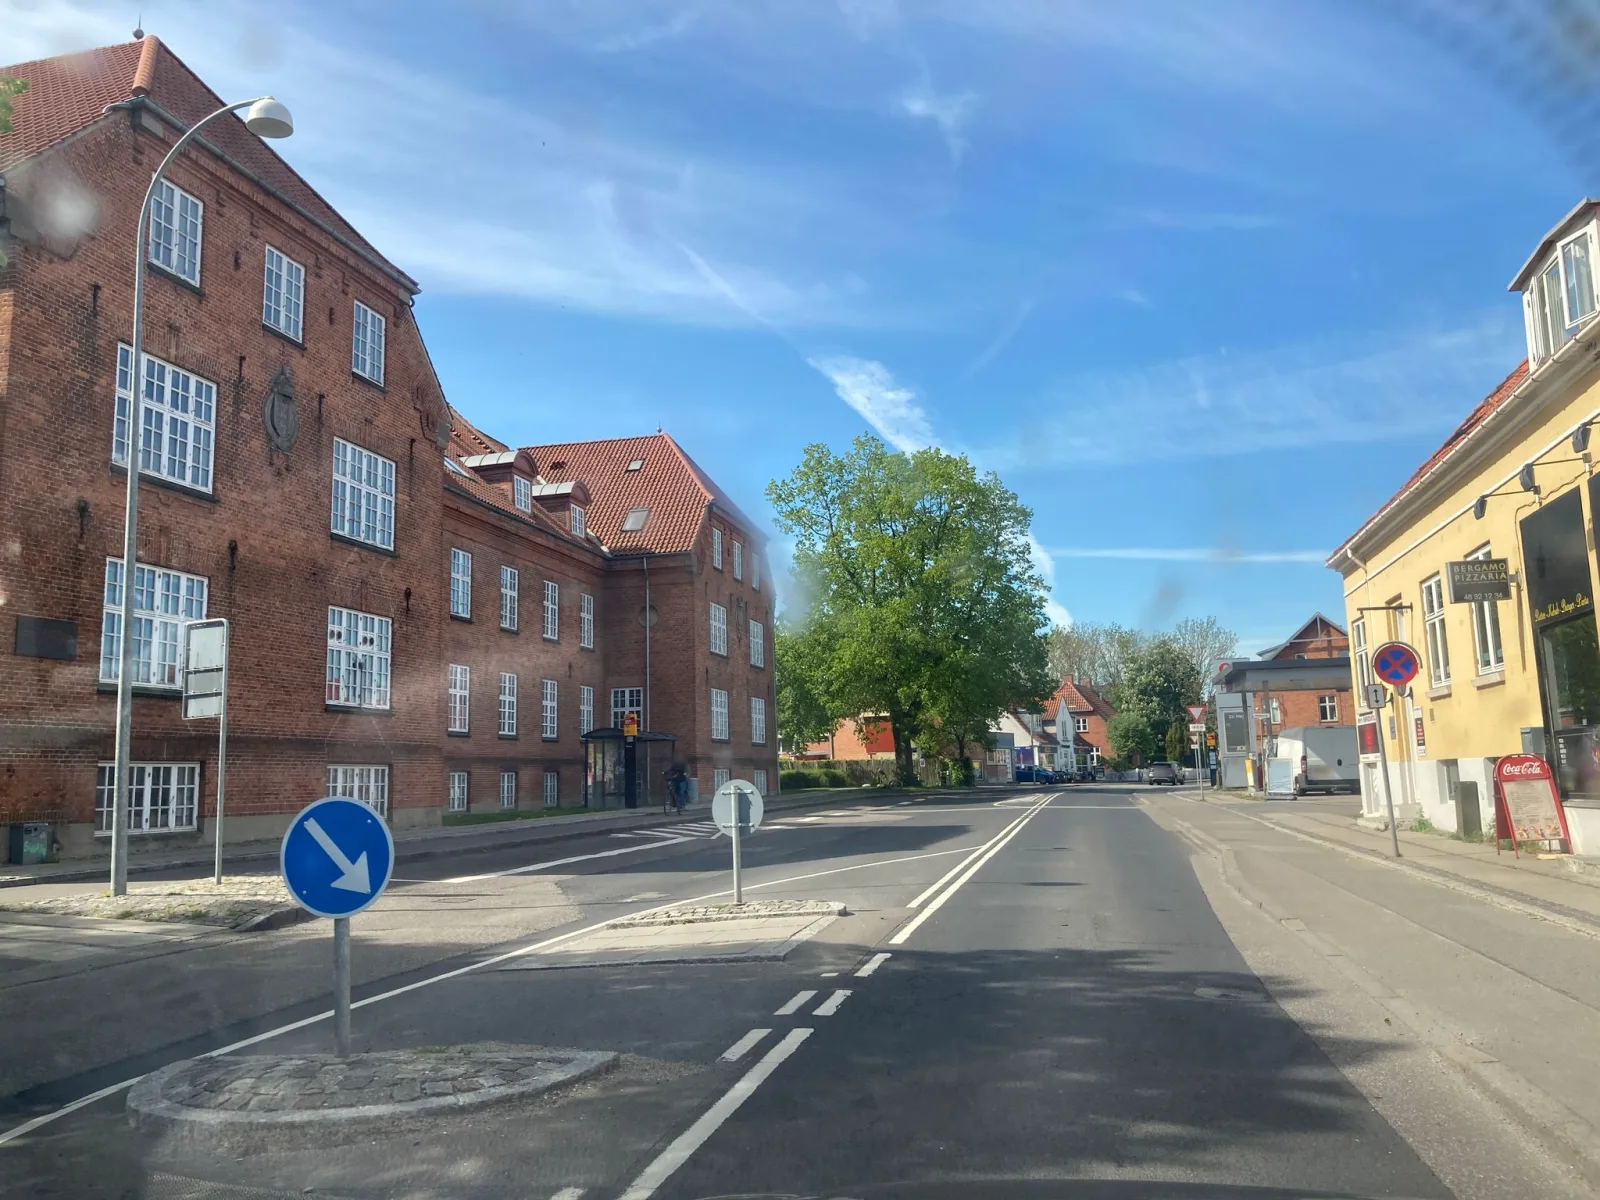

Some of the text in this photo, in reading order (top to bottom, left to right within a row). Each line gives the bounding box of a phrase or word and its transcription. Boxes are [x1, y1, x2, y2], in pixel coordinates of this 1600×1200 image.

[1453, 563, 1506, 573] BERGAMO
[1454, 572, 1507, 582] PIZZARIA
[1503, 762, 1542, 775] Coca-Cola
